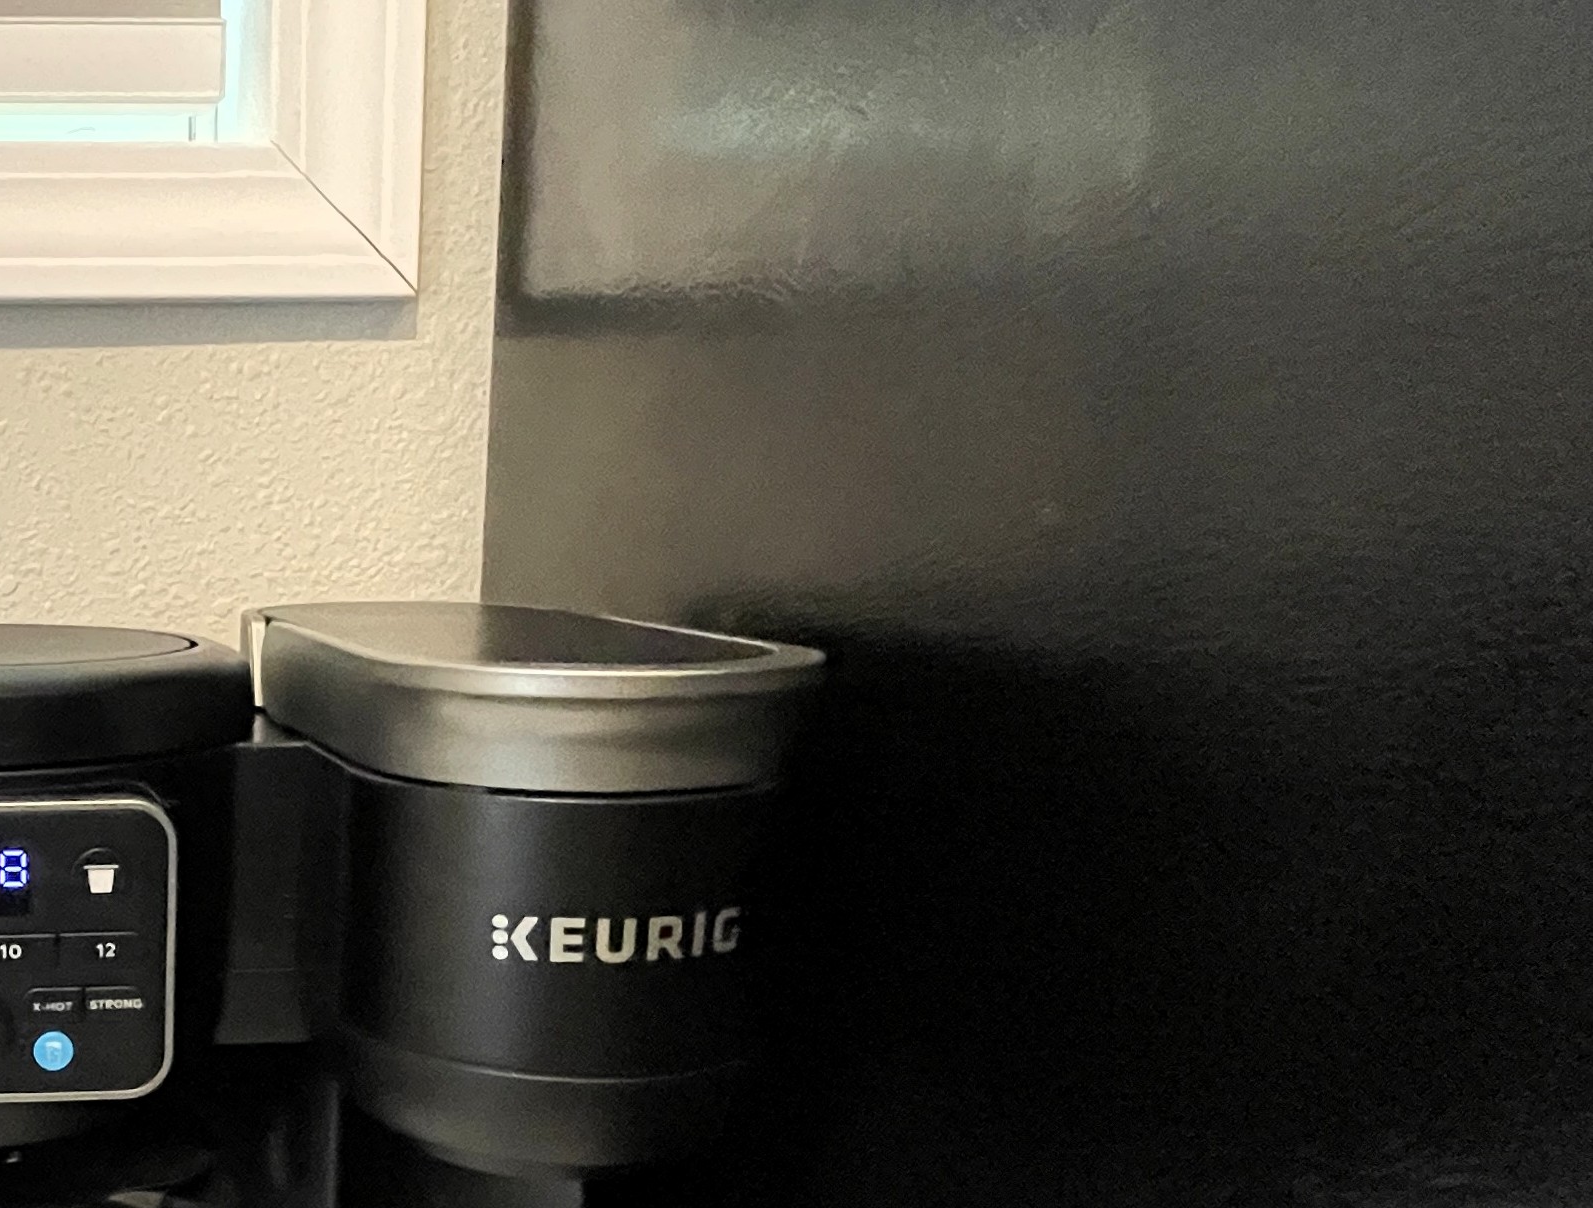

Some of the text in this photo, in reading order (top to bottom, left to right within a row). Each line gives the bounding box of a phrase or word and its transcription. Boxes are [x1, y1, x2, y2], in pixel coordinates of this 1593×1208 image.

[491, 907, 741, 963] KEURIG
[0, 944, 22, 960] 10
[96, 942, 116, 958] 12
[89, 998, 143, 1010] STRONG
